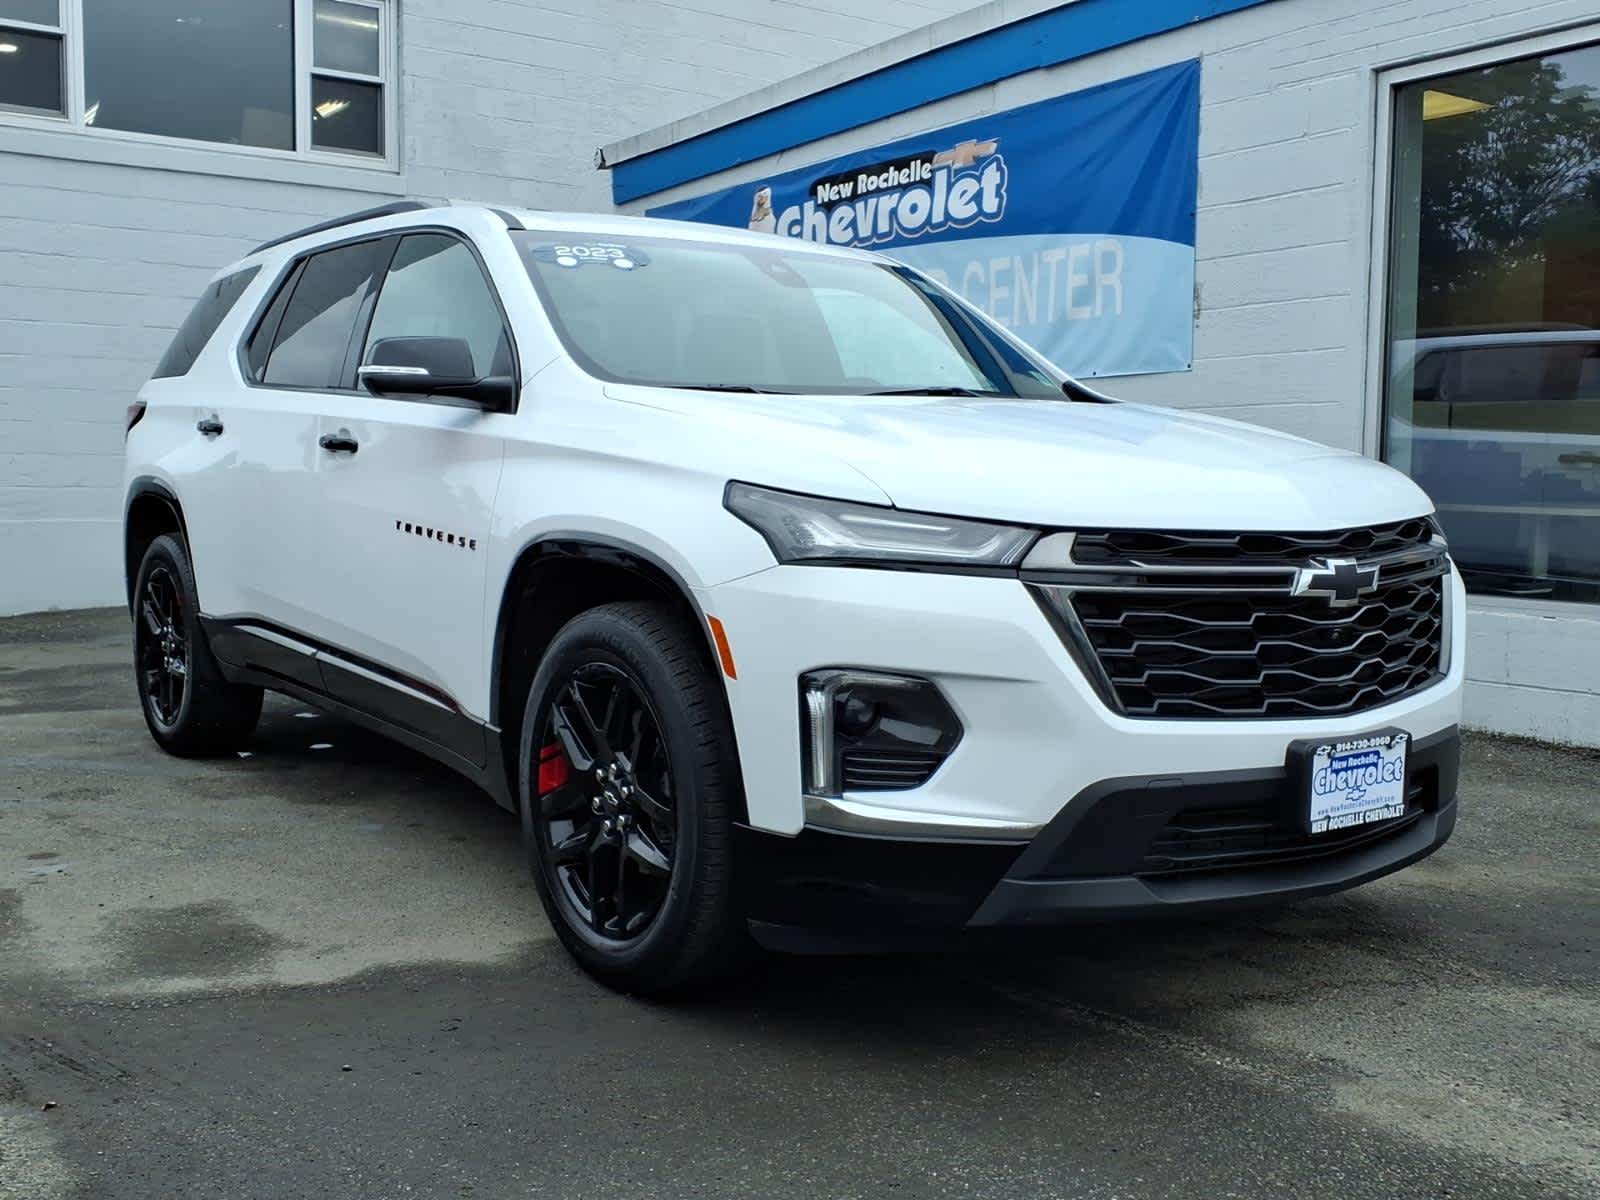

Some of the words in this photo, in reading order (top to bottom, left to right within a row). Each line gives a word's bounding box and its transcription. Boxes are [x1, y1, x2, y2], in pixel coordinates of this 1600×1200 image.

[817, 181, 854, 204] New
[857, 159, 933, 193] Rochelle
[553, 245, 625, 259] 2023
[961, 238, 1125, 328] CENTER
[395, 520, 477, 551] TRAVERSE
[1313, 756, 1403, 796] Chevrolet
[1332, 759, 1348, 770] New
[1349, 753, 1379, 767] Rochelle
[1311, 819, 1328, 834] NEW
[1329, 812, 1364, 831] ROCHELLE
[1365, 803, 1405, 824] CHEVROLET
